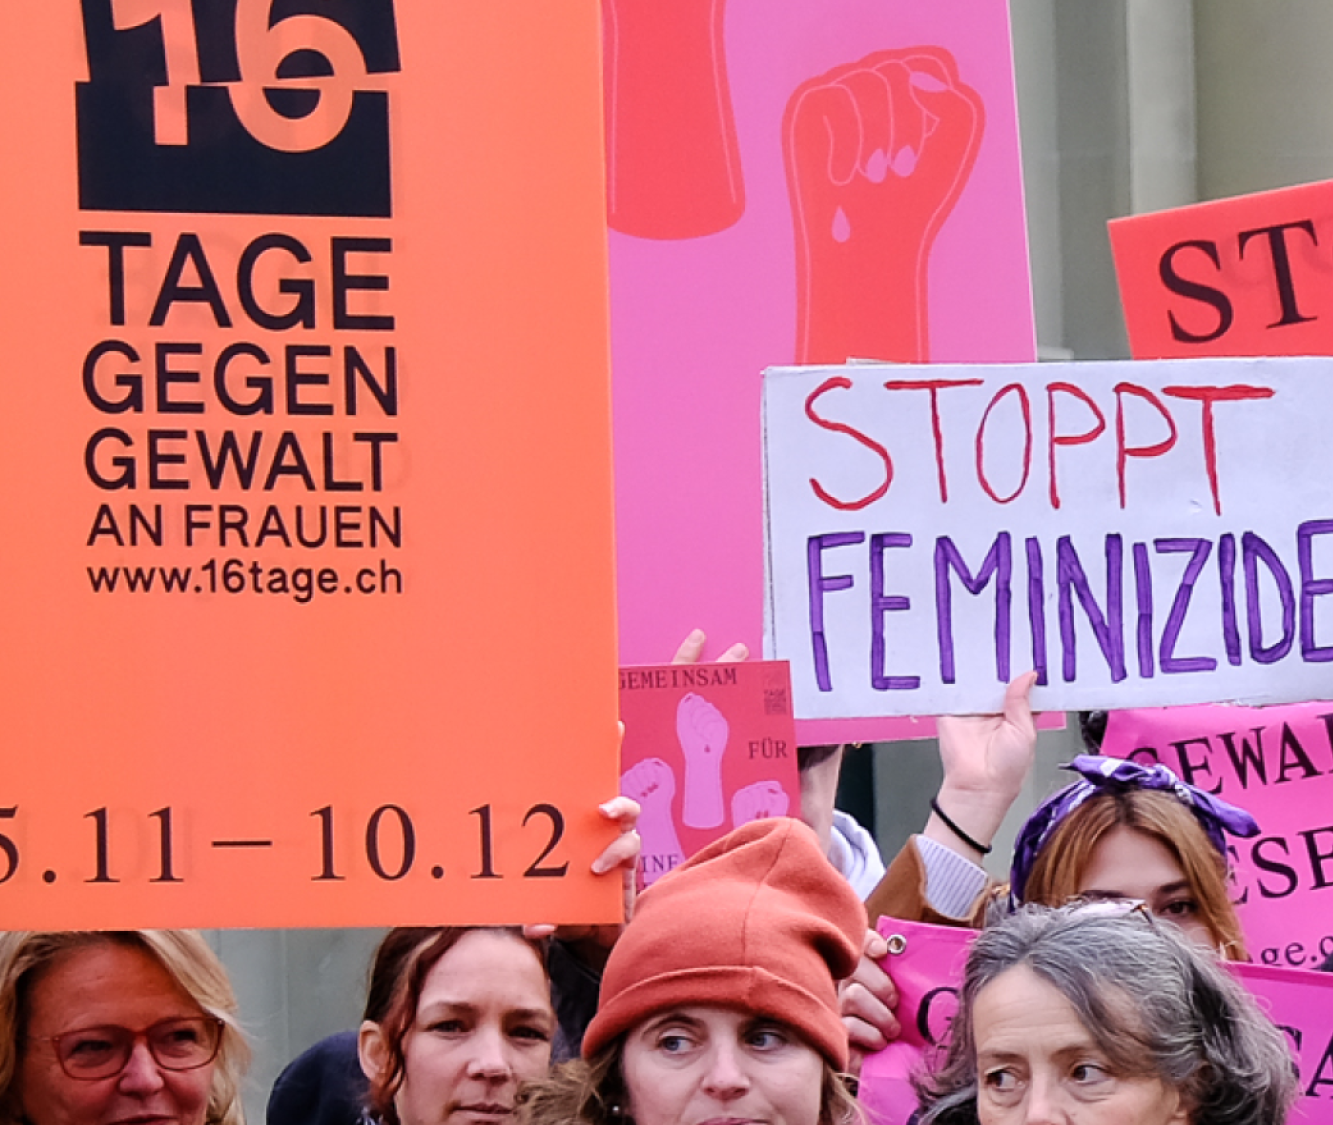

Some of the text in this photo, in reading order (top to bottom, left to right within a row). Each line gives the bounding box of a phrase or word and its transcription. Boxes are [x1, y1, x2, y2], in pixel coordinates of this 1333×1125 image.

[79, 231, 395, 331] TAGE
[82, 340, 398, 416] GEGEN
[85, 429, 399, 492] GEWALT
[805, 376, 1276, 517] STOPPT
[87, 505, 402, 549] AN FRAUEN
[87, 558, 402, 602] www.16tage.ch
[748, 738, 788, 759] FÜR
